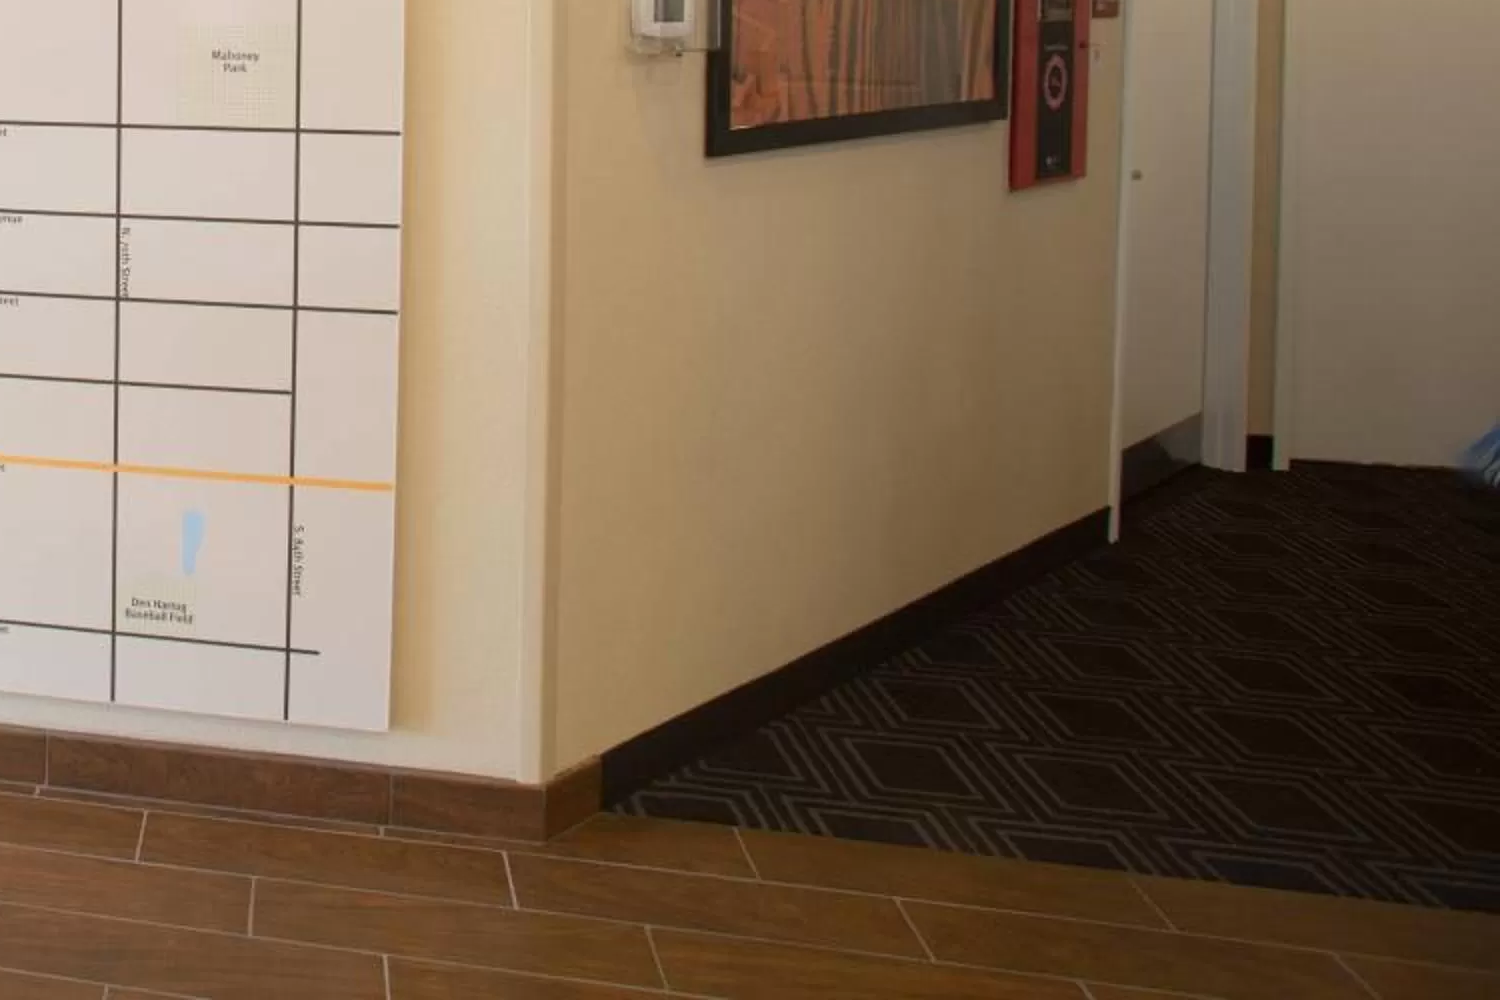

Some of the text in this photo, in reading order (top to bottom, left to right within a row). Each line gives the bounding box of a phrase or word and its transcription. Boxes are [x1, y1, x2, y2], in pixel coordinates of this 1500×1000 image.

[211, 49, 260, 73] Mahoney Park
[293, 564, 305, 597] Street
[168, 611, 193, 625] Field
